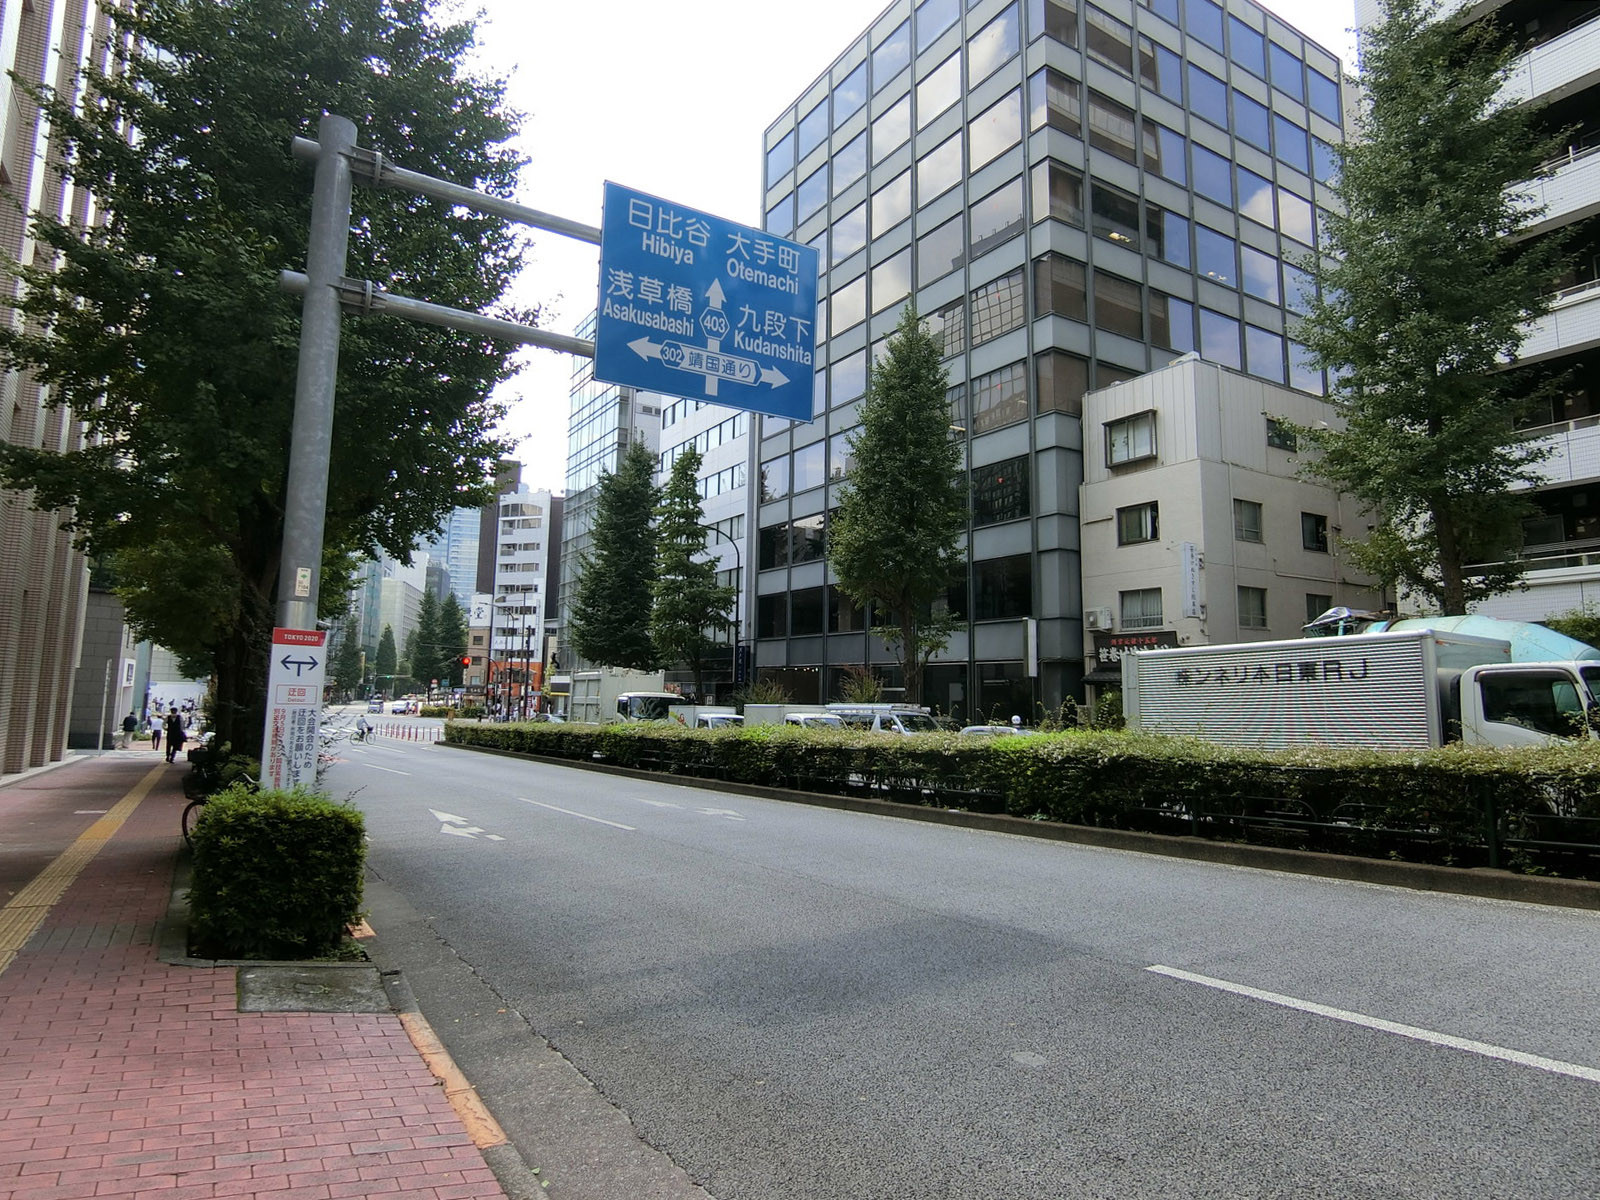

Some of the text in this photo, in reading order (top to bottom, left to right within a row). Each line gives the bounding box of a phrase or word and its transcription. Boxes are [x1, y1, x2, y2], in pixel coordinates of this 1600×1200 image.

[628, 198, 711, 247] 日比谷
[642, 232, 694, 265] Hibiya
[726, 232, 800, 274] 大手町
[606, 267, 694, 315] 浅草橋
[726, 257, 799, 295] Otemachi
[602, 297, 694, 337] Asakusabashi
[703, 316, 726, 334] 403
[737, 304, 811, 343] 九段下
[662, 346, 683, 364] 302
[688, 351, 751, 378] 靖国通り
[733, 330, 812, 365] Kudanshita
[284, 633, 304, 641] TOKYO
[288, 688, 306, 696] 迂回
